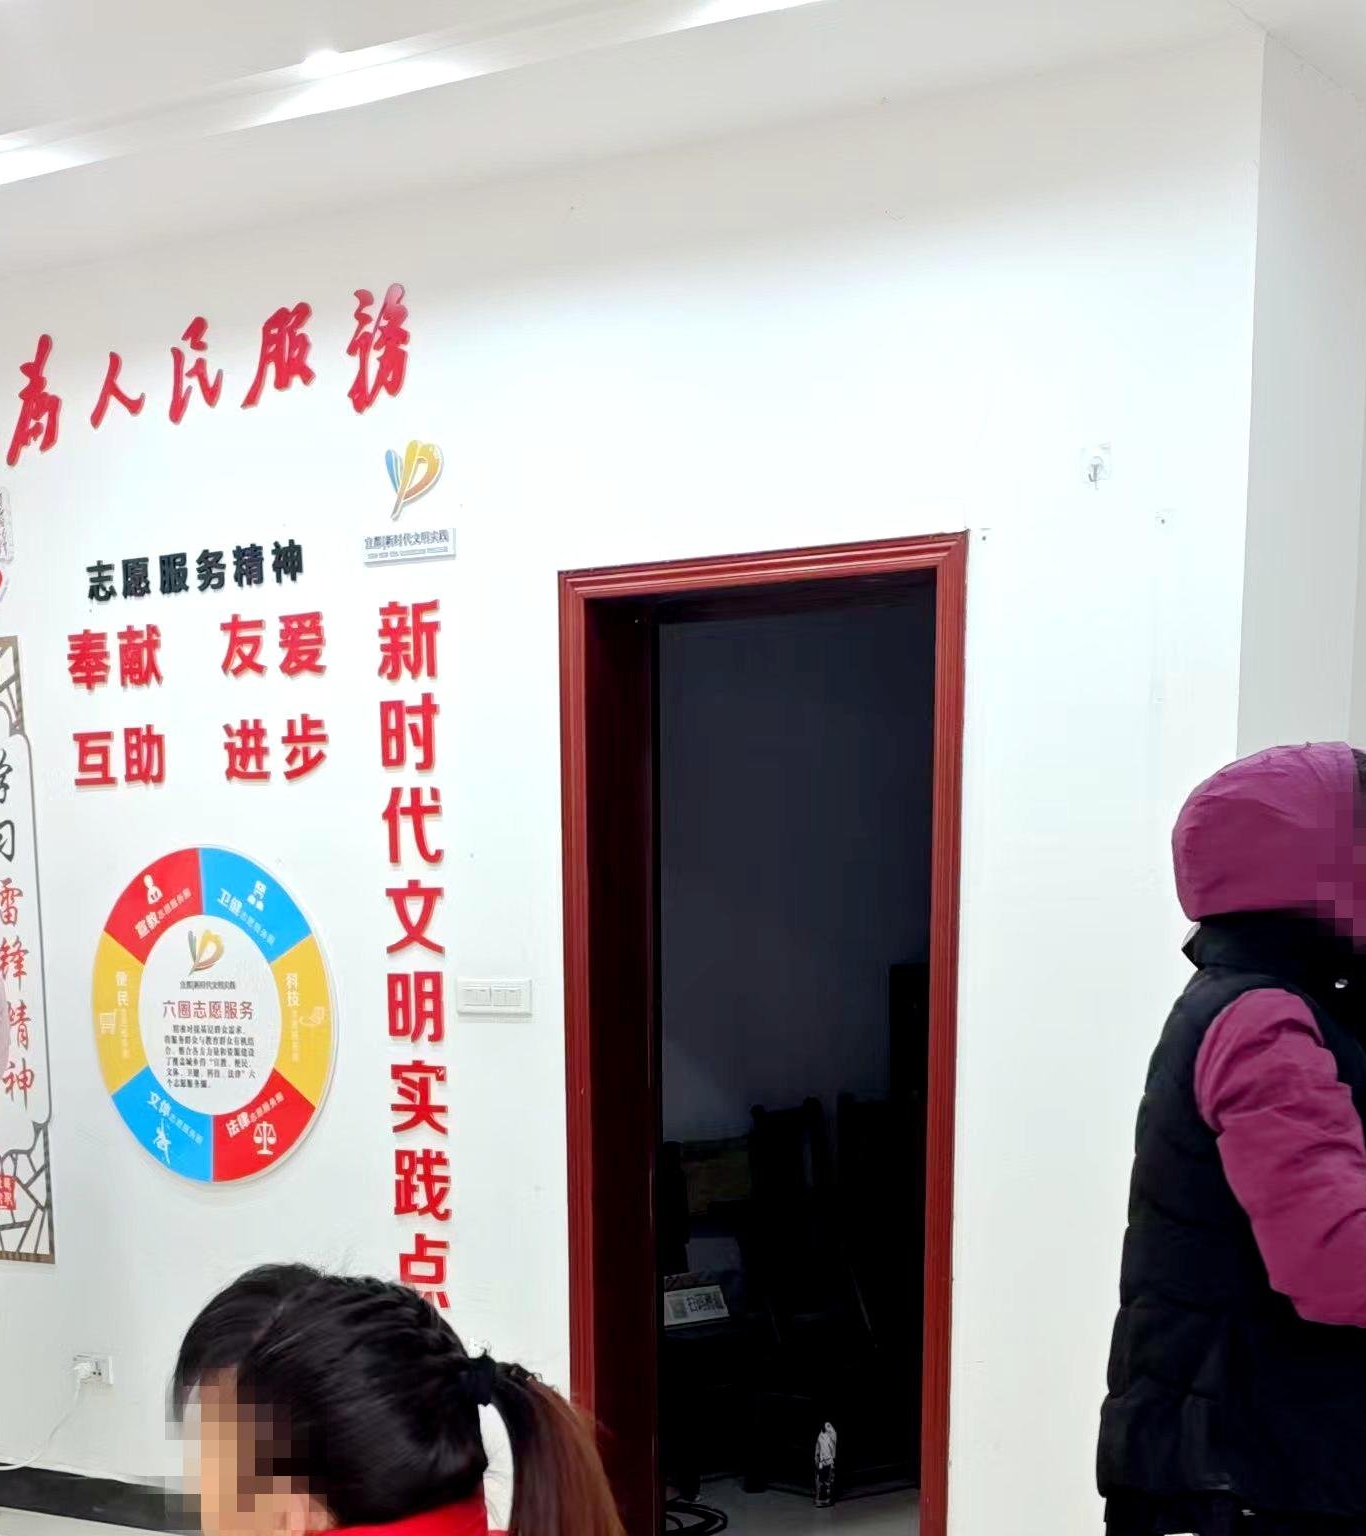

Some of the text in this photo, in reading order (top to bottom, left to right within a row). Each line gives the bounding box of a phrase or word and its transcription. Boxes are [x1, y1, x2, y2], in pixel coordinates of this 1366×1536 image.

[85, 539, 305, 602] 志愿服务精神
[67, 624, 164, 693] 奉献
[220, 611, 327, 680] 友爱
[72, 724, 167, 789] 互助
[223, 714, 330, 783] 进步
[376, 599, 453, 1312] 新时代文明实践点
